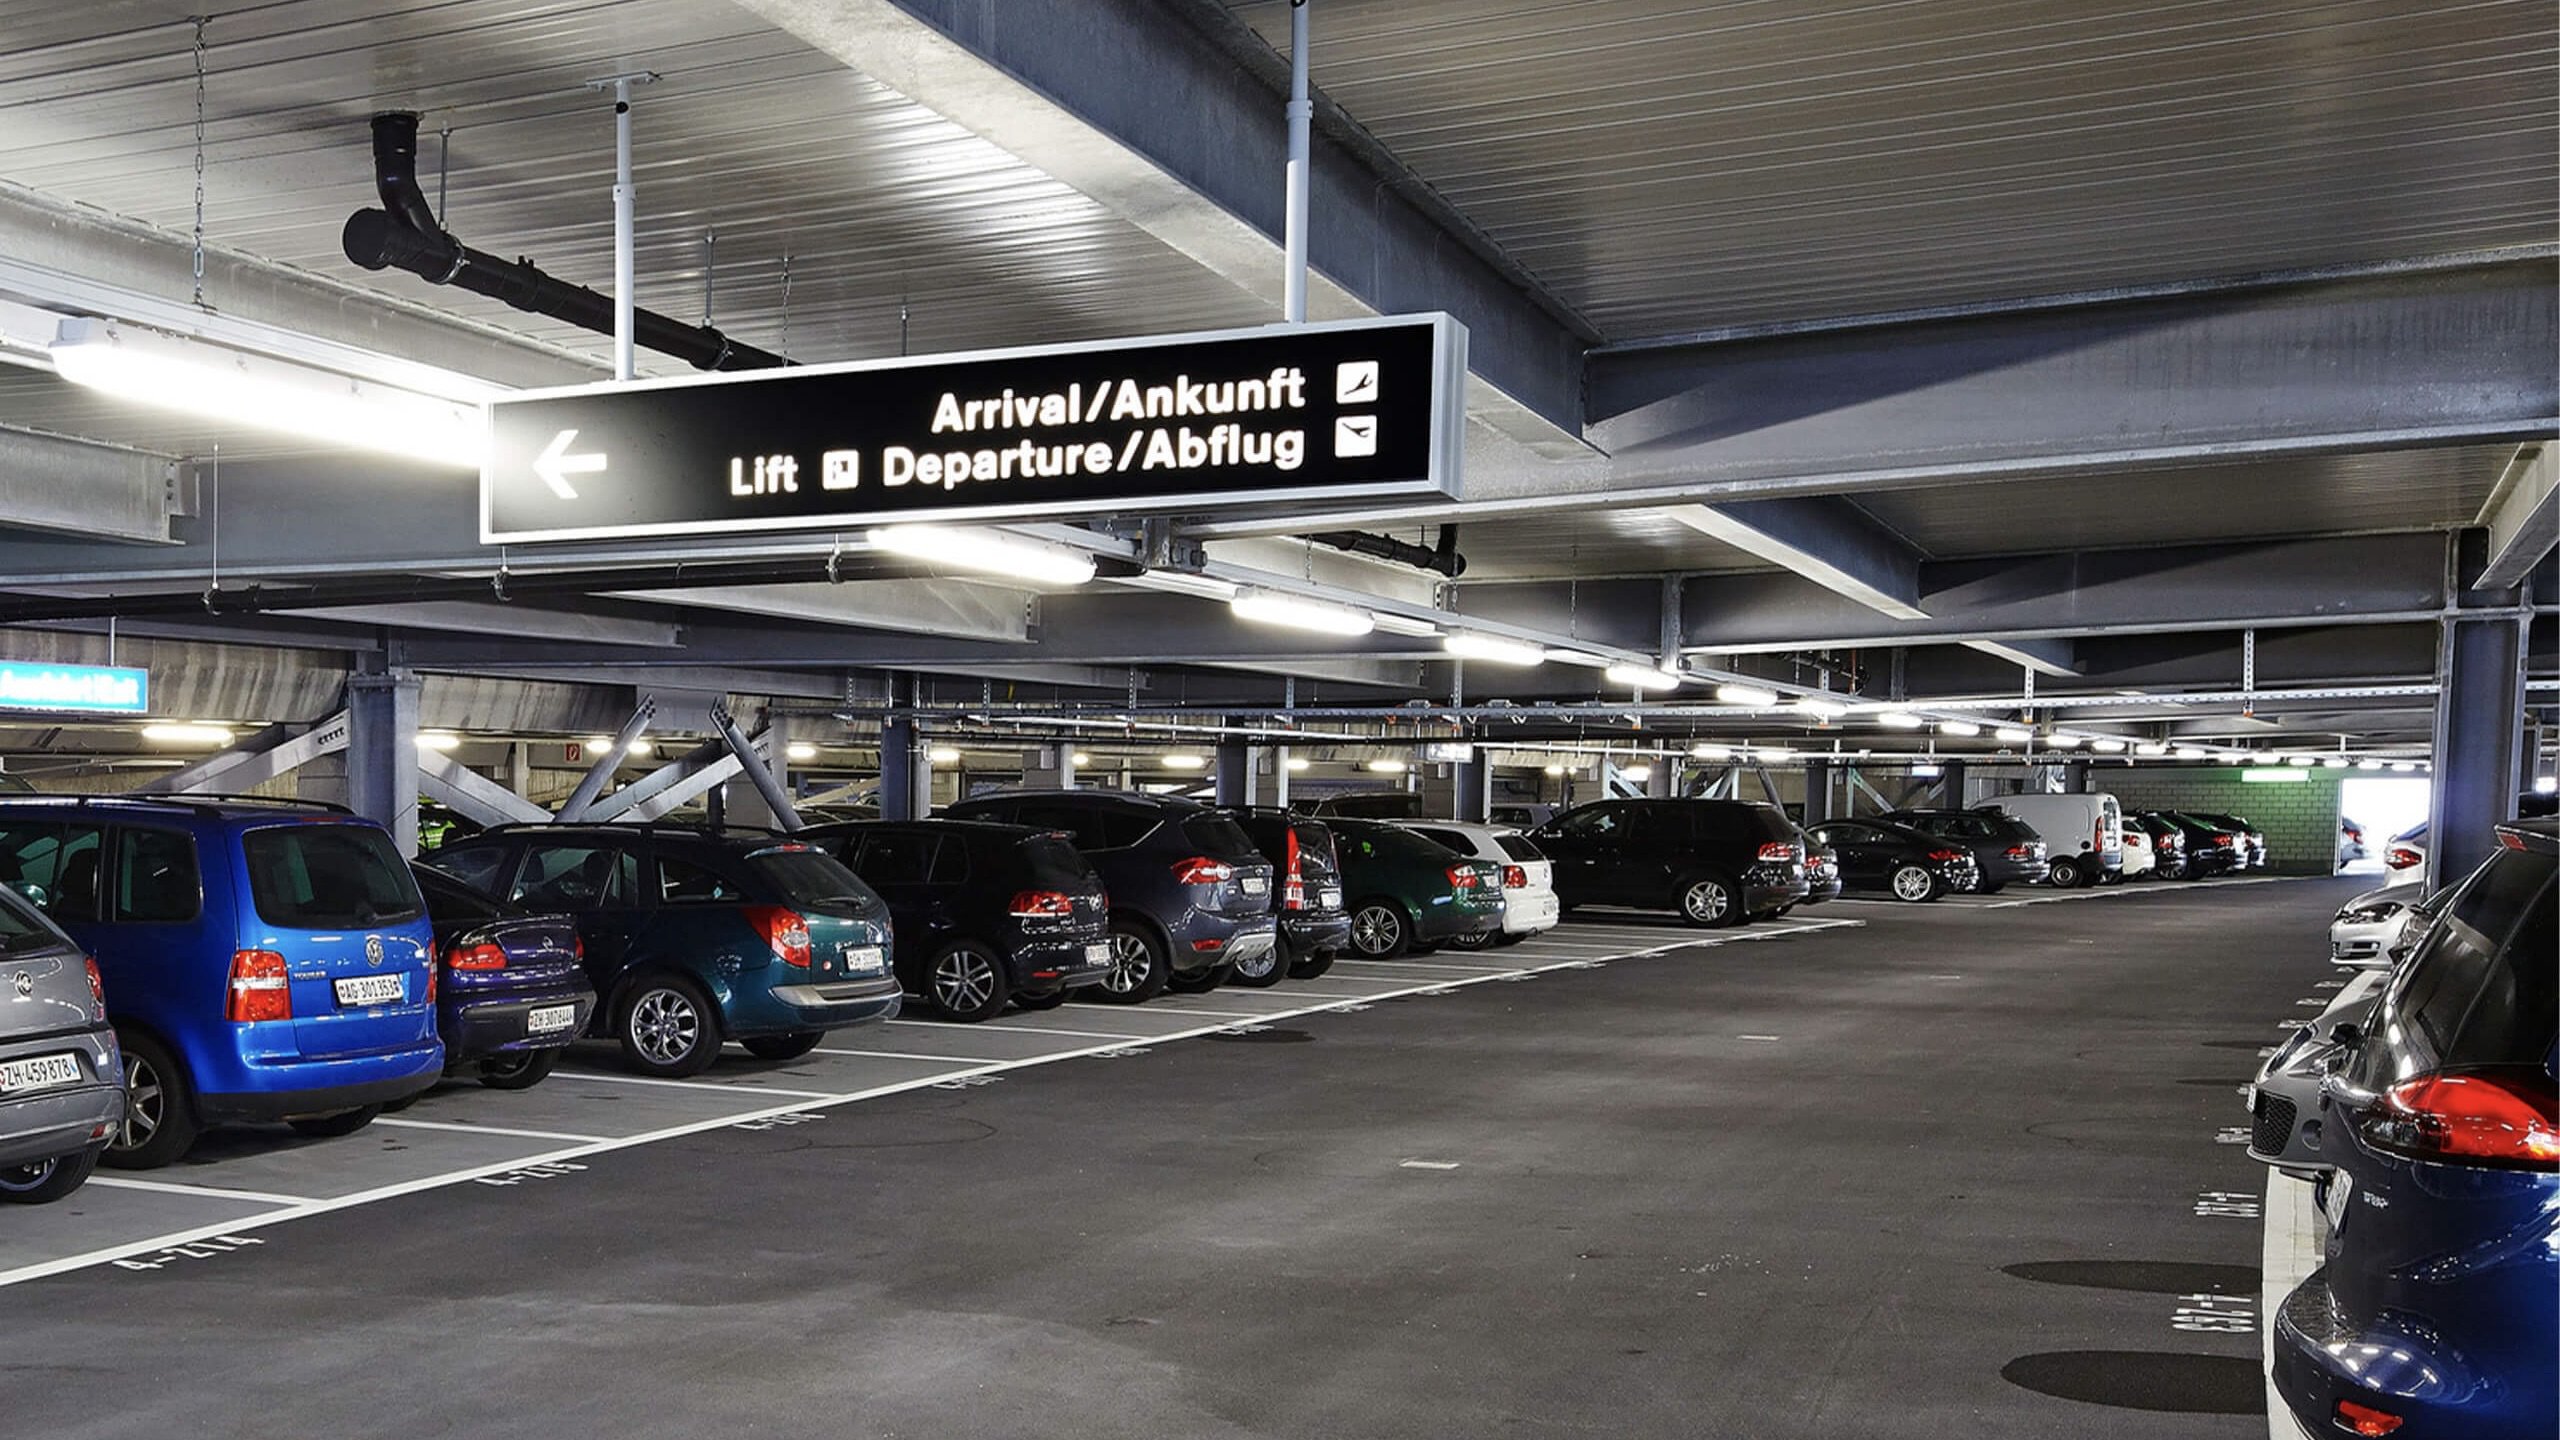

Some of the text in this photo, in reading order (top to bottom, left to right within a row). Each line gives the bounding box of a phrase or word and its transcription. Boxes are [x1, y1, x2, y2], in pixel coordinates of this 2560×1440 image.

[931, 367, 1305, 433] Arrival/Ankunft
[730, 423, 1304, 497] Lift Departure/Abflug
